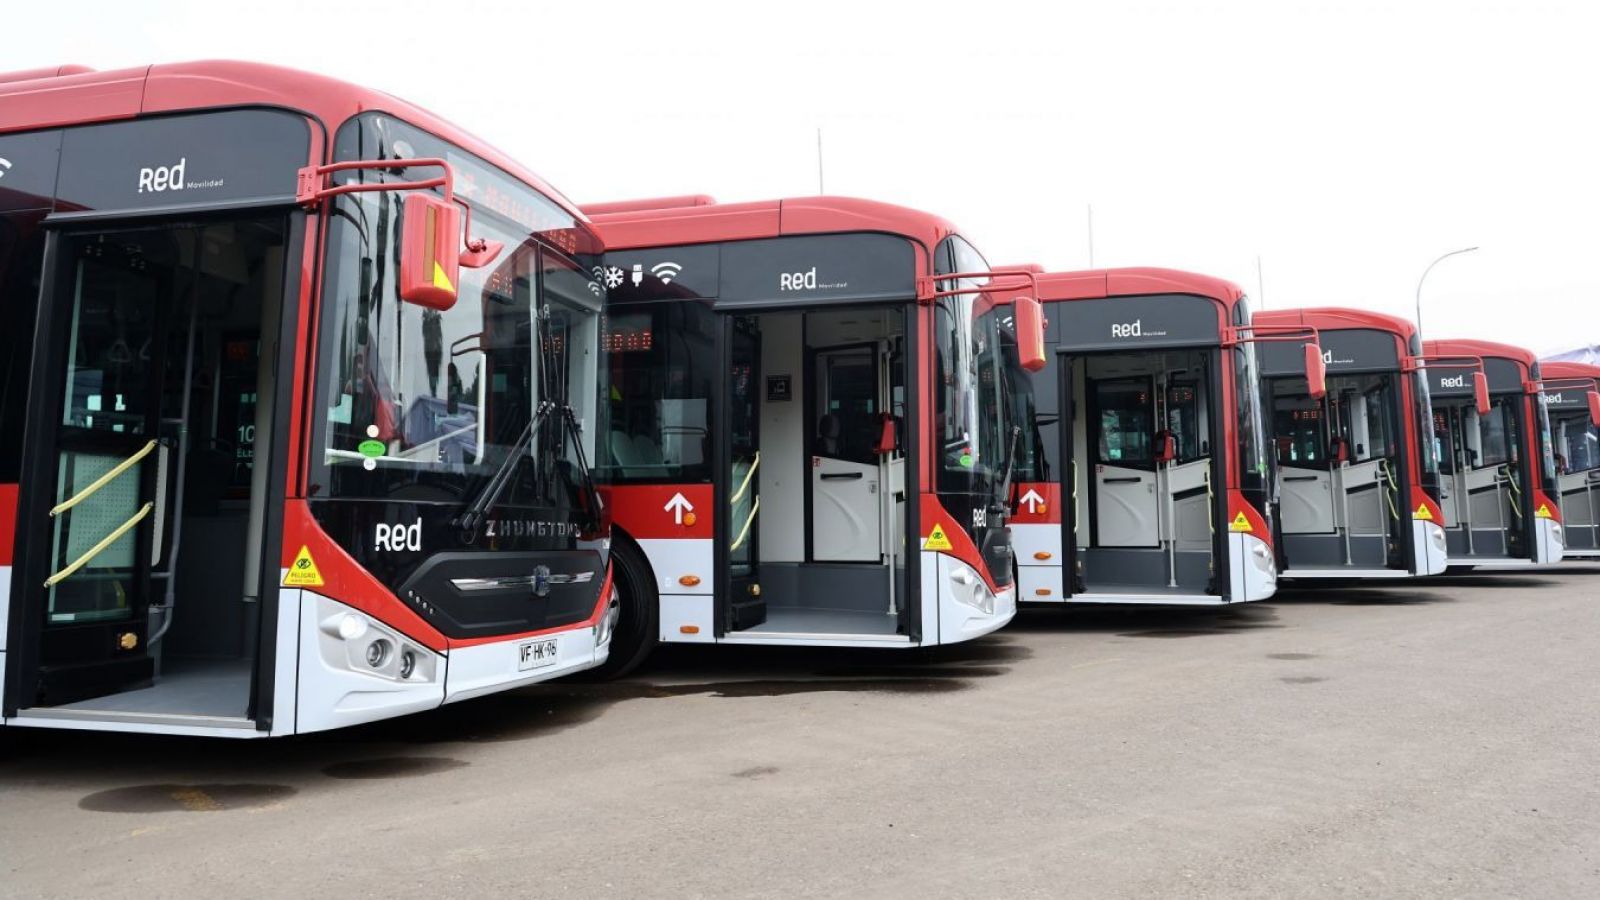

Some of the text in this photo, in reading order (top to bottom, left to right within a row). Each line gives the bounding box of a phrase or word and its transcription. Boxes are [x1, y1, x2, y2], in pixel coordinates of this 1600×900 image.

[138, 157, 224, 194] Red Movilidad
[780, 266, 817, 291] Red
[1111, 319, 1142, 338] Red
[1440, 374, 1463, 388] Red
[972, 505, 987, 527] Red
[374, 517, 422, 552] Red
